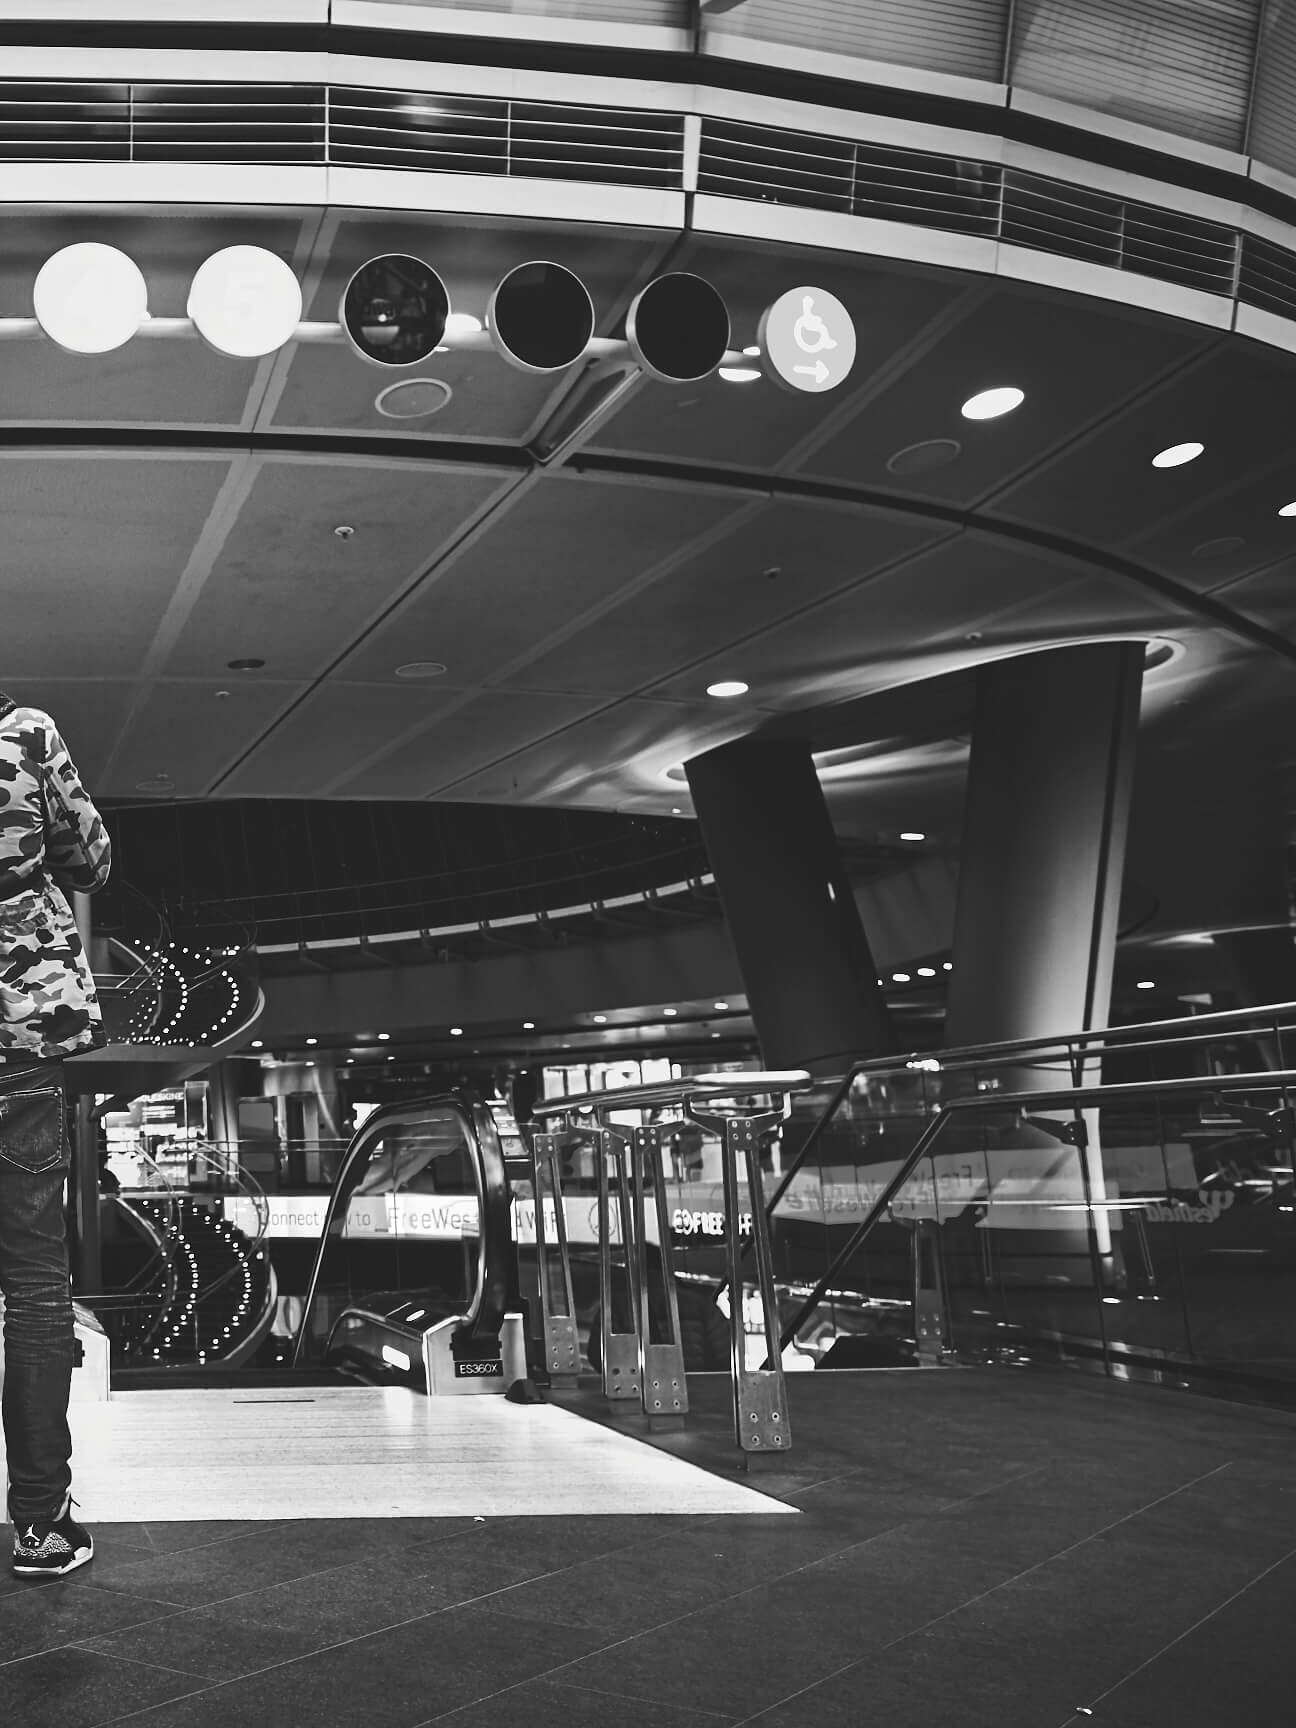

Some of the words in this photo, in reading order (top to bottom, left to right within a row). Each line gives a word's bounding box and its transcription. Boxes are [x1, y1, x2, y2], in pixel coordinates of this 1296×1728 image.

[63, 268, 115, 329] 4
[223, 271, 270, 332] 5
[270, 1209, 320, 1226] onnect
[459, 1363, 498, 1374] ES360X
